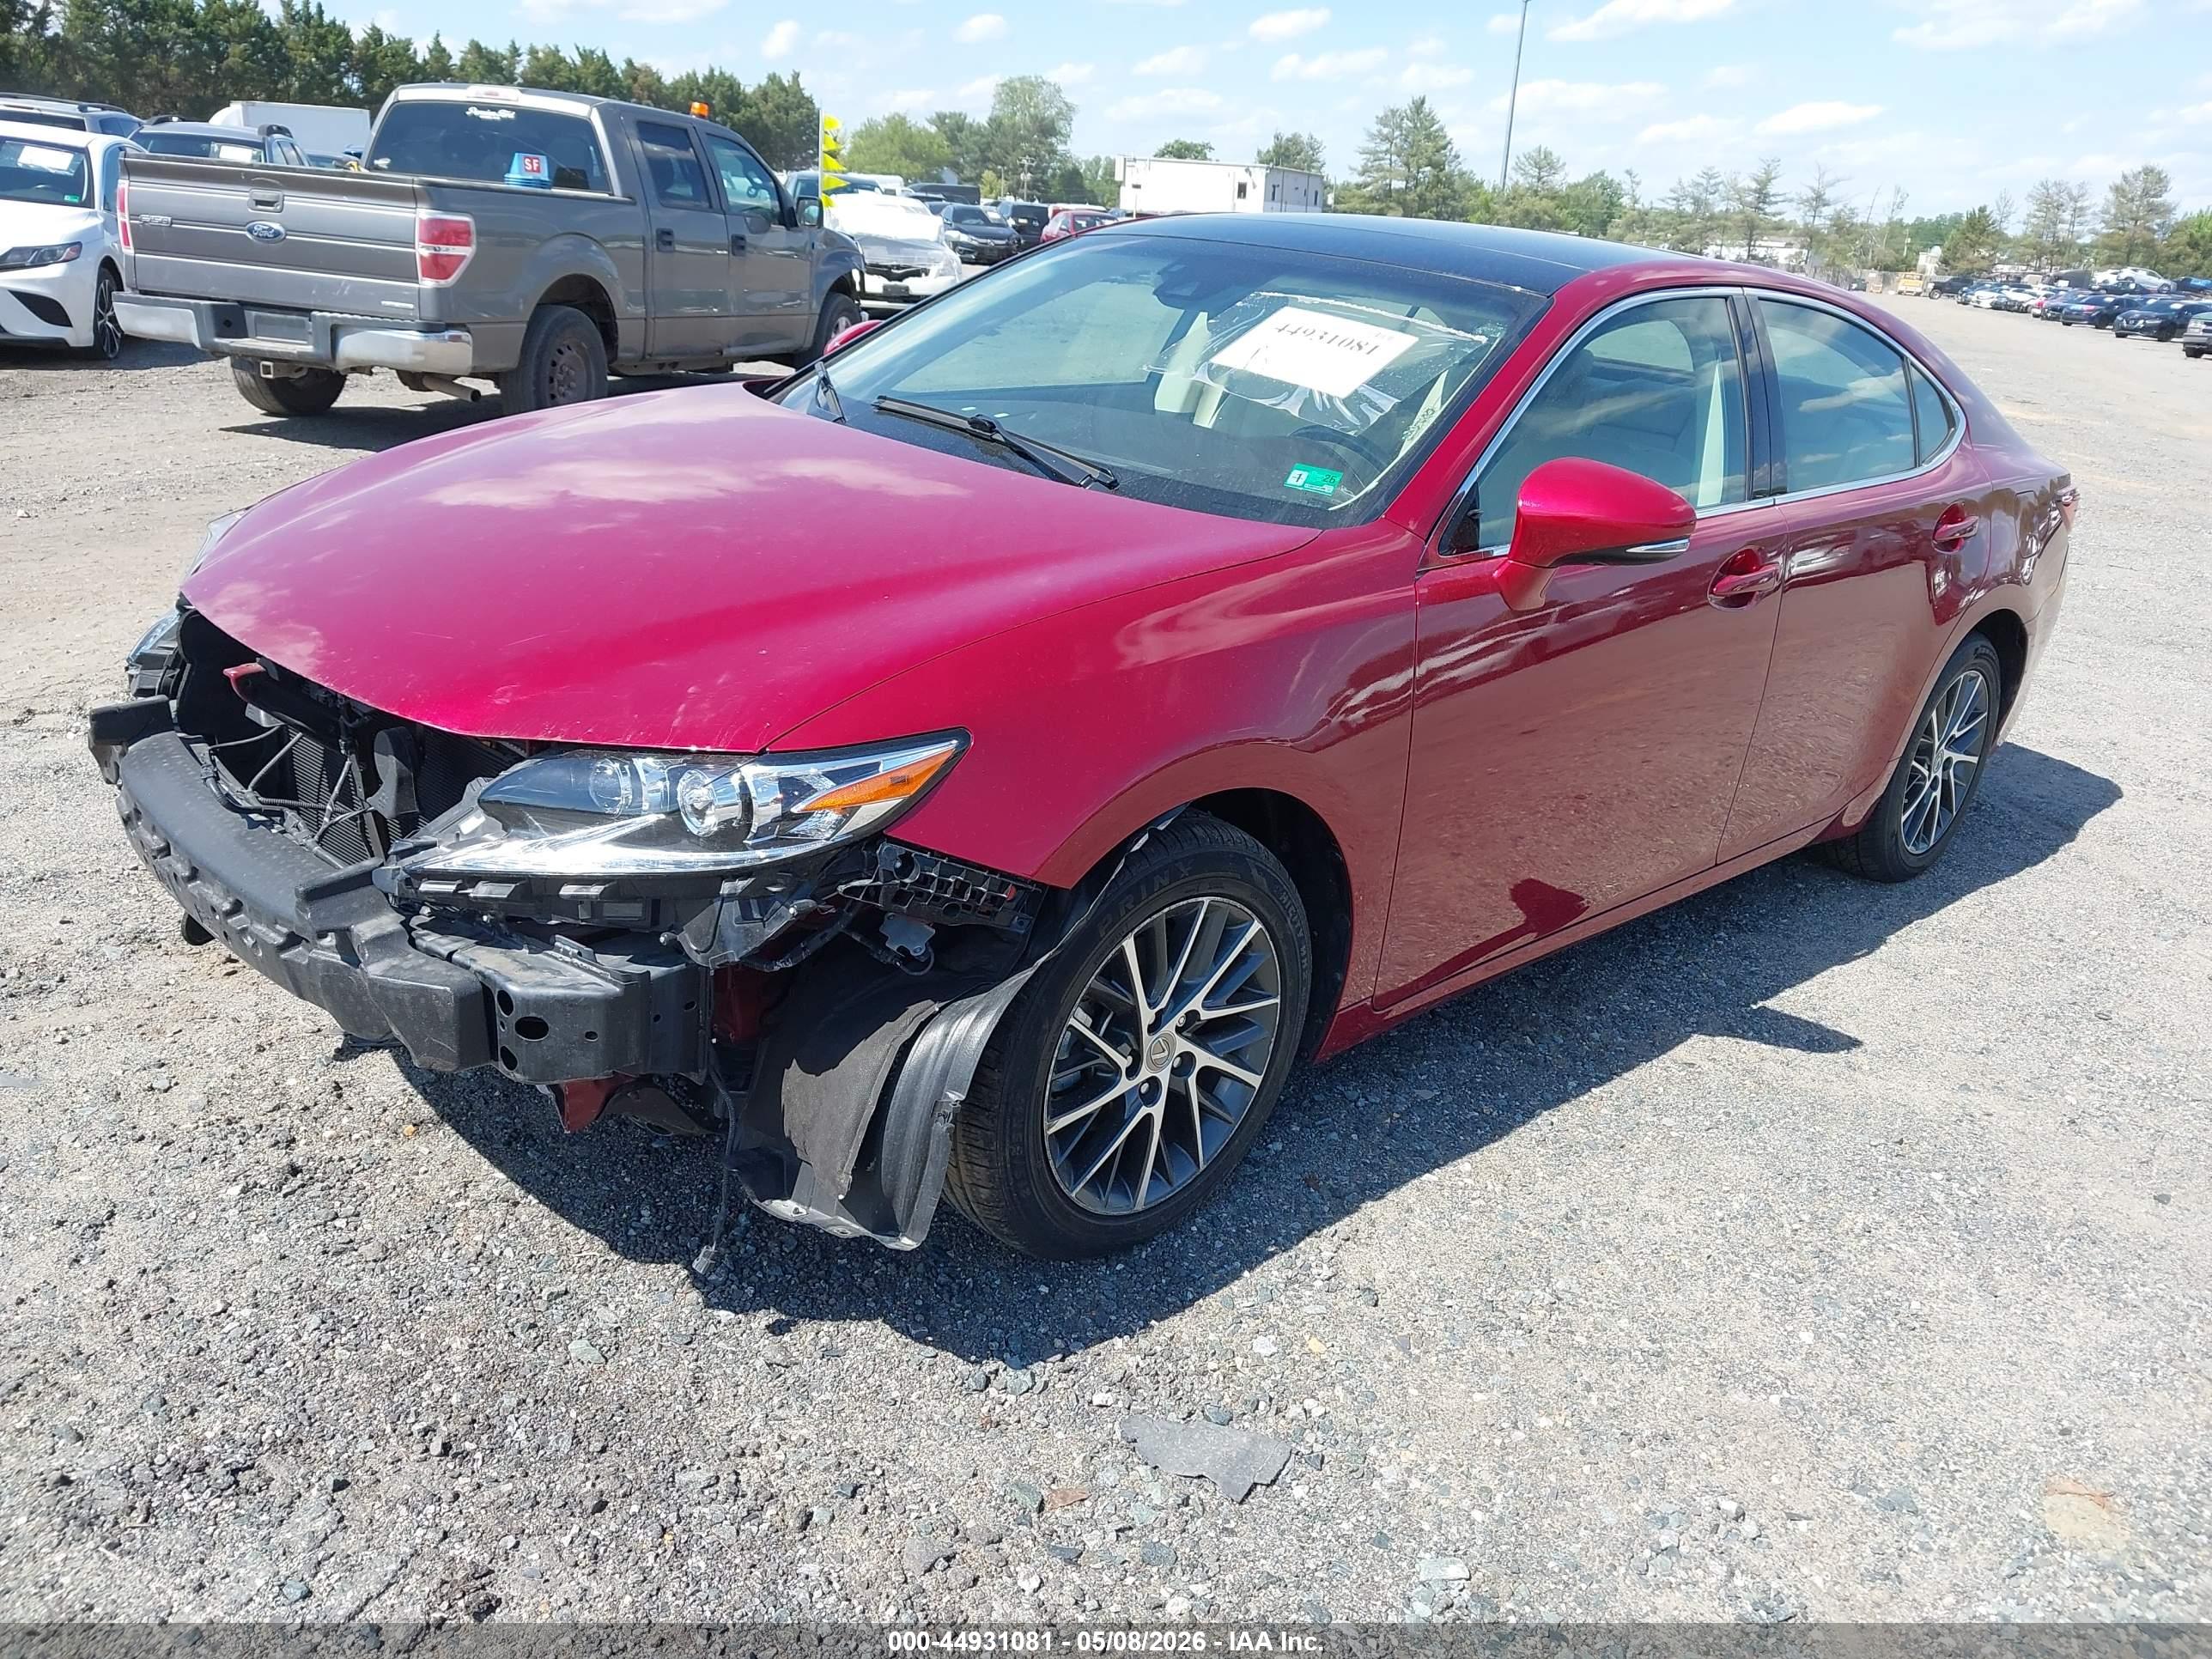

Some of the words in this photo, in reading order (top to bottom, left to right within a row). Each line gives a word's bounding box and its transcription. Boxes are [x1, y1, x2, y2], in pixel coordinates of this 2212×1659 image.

[525, 157, 539, 171] SF
[1274, 323, 1381, 356] 44931081
[1098, 859, 1195, 938] PRINX
